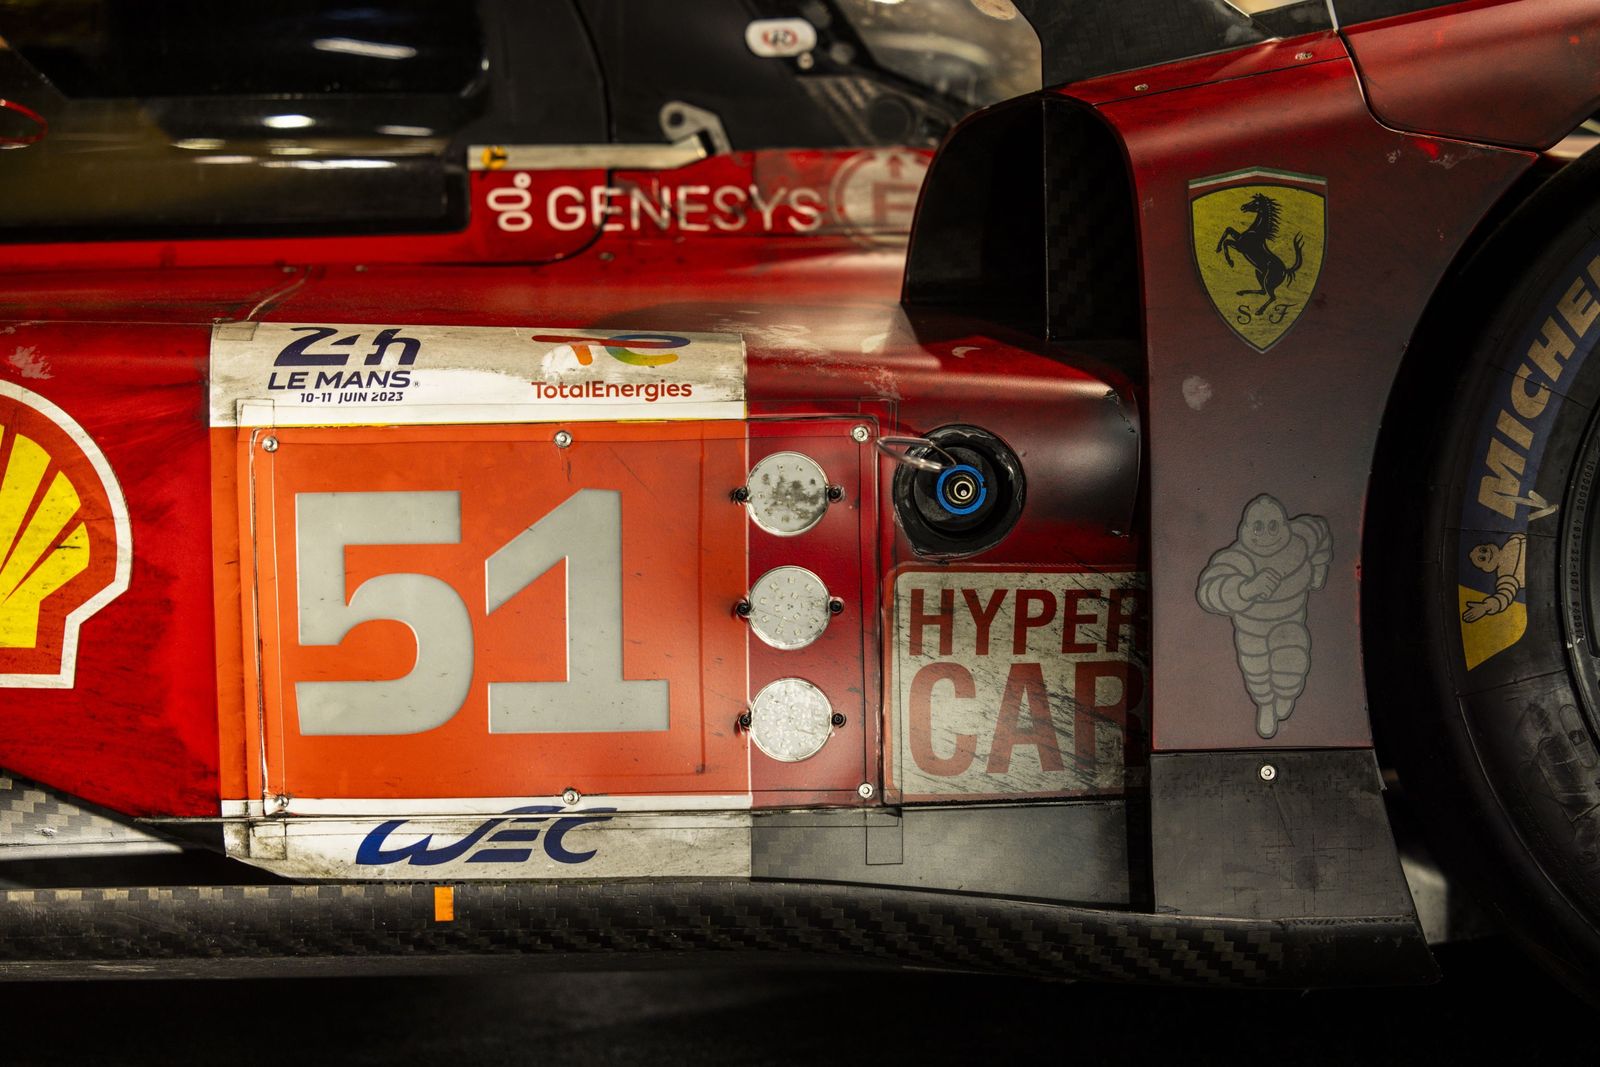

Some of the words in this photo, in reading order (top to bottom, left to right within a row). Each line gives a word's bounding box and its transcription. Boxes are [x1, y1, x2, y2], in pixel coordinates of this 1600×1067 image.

[547, 185, 823, 232] GENESYS
[268, 371, 309, 390] LE
[300, 392, 332, 403] 10-11
[337, 392, 368, 404] JUIN
[370, 391, 404, 402] 2023
[531, 379, 693, 402] TotalEnergies
[294, 487, 671, 736] 51
[908, 588, 1149, 656] HYPER
[908, 661, 1146, 776] CAR
[355, 805, 618, 866] WEC
